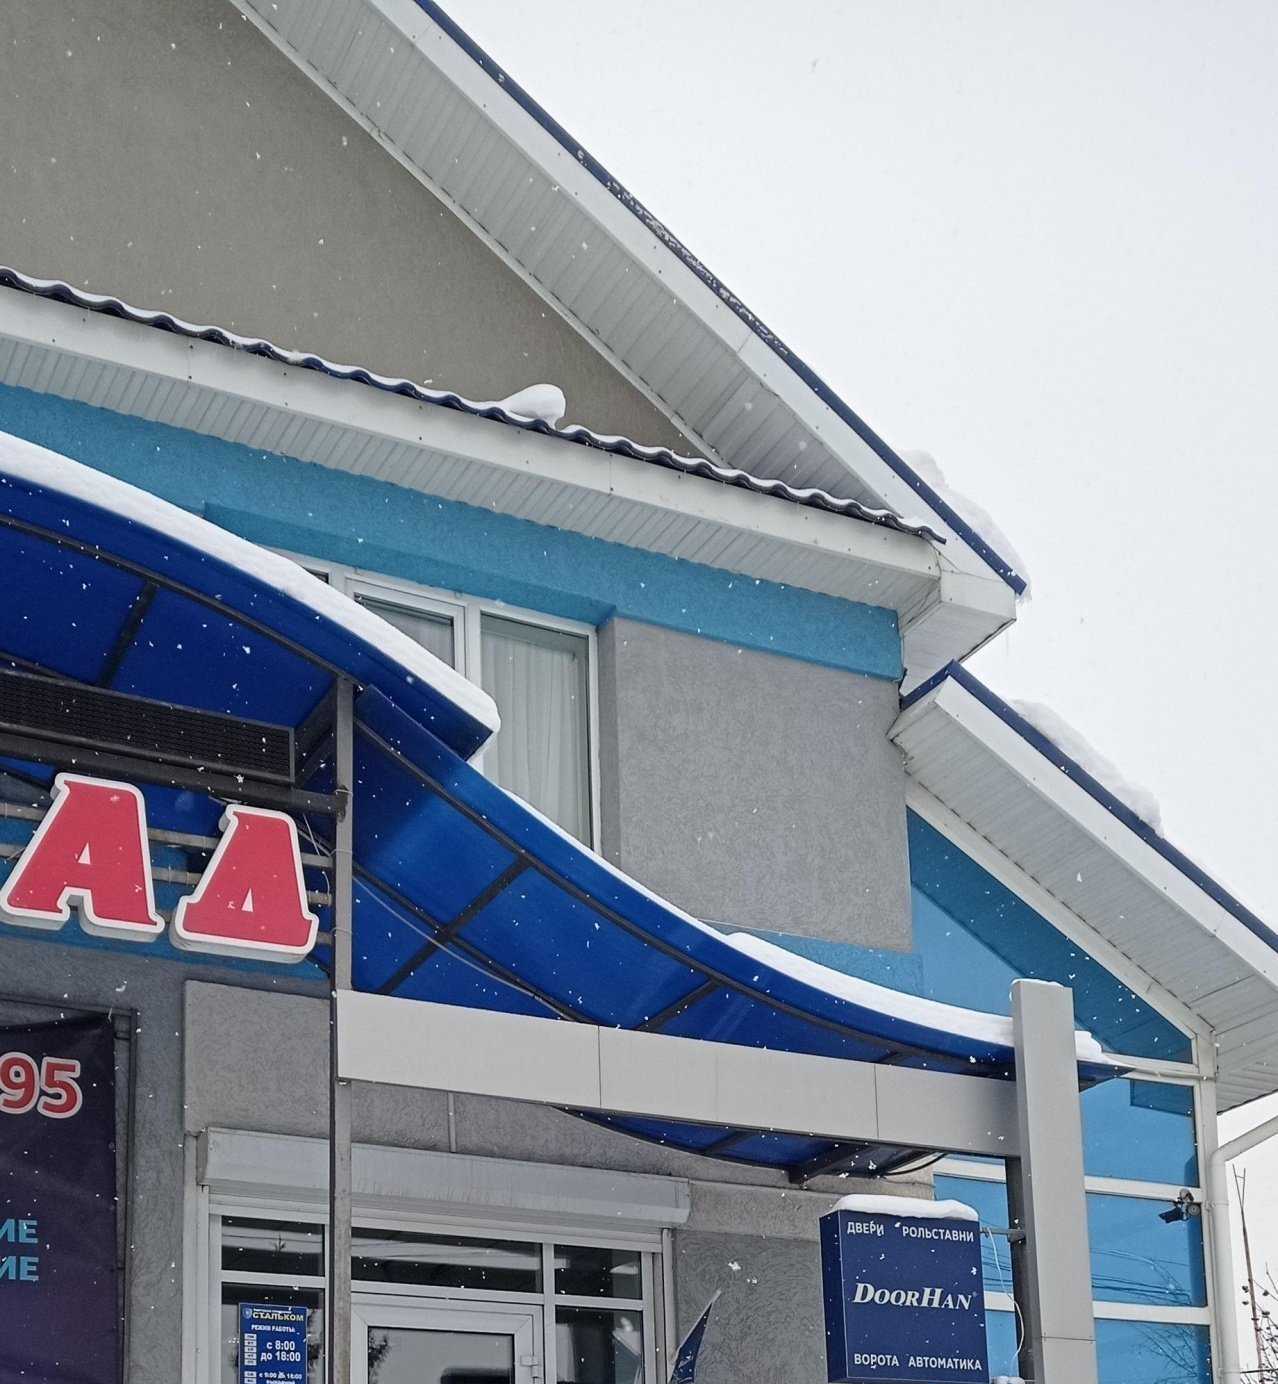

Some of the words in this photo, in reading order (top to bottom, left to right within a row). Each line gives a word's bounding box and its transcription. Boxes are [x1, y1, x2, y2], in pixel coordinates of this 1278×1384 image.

[0, 1052, 82, 1119] 95
[846, 1221, 885, 1236] ДВЕРИ
[902, 1226, 974, 1242] РОЛЬСТАВНИ
[275, 1340, 295, 1351] 8:00
[261, 1352, 273, 1361] до
[275, 1351, 301, 1362] 18:00
[854, 1353, 900, 1367] ВОРОТА
[908, 1356, 982, 1371] АВТОМАТИКА
